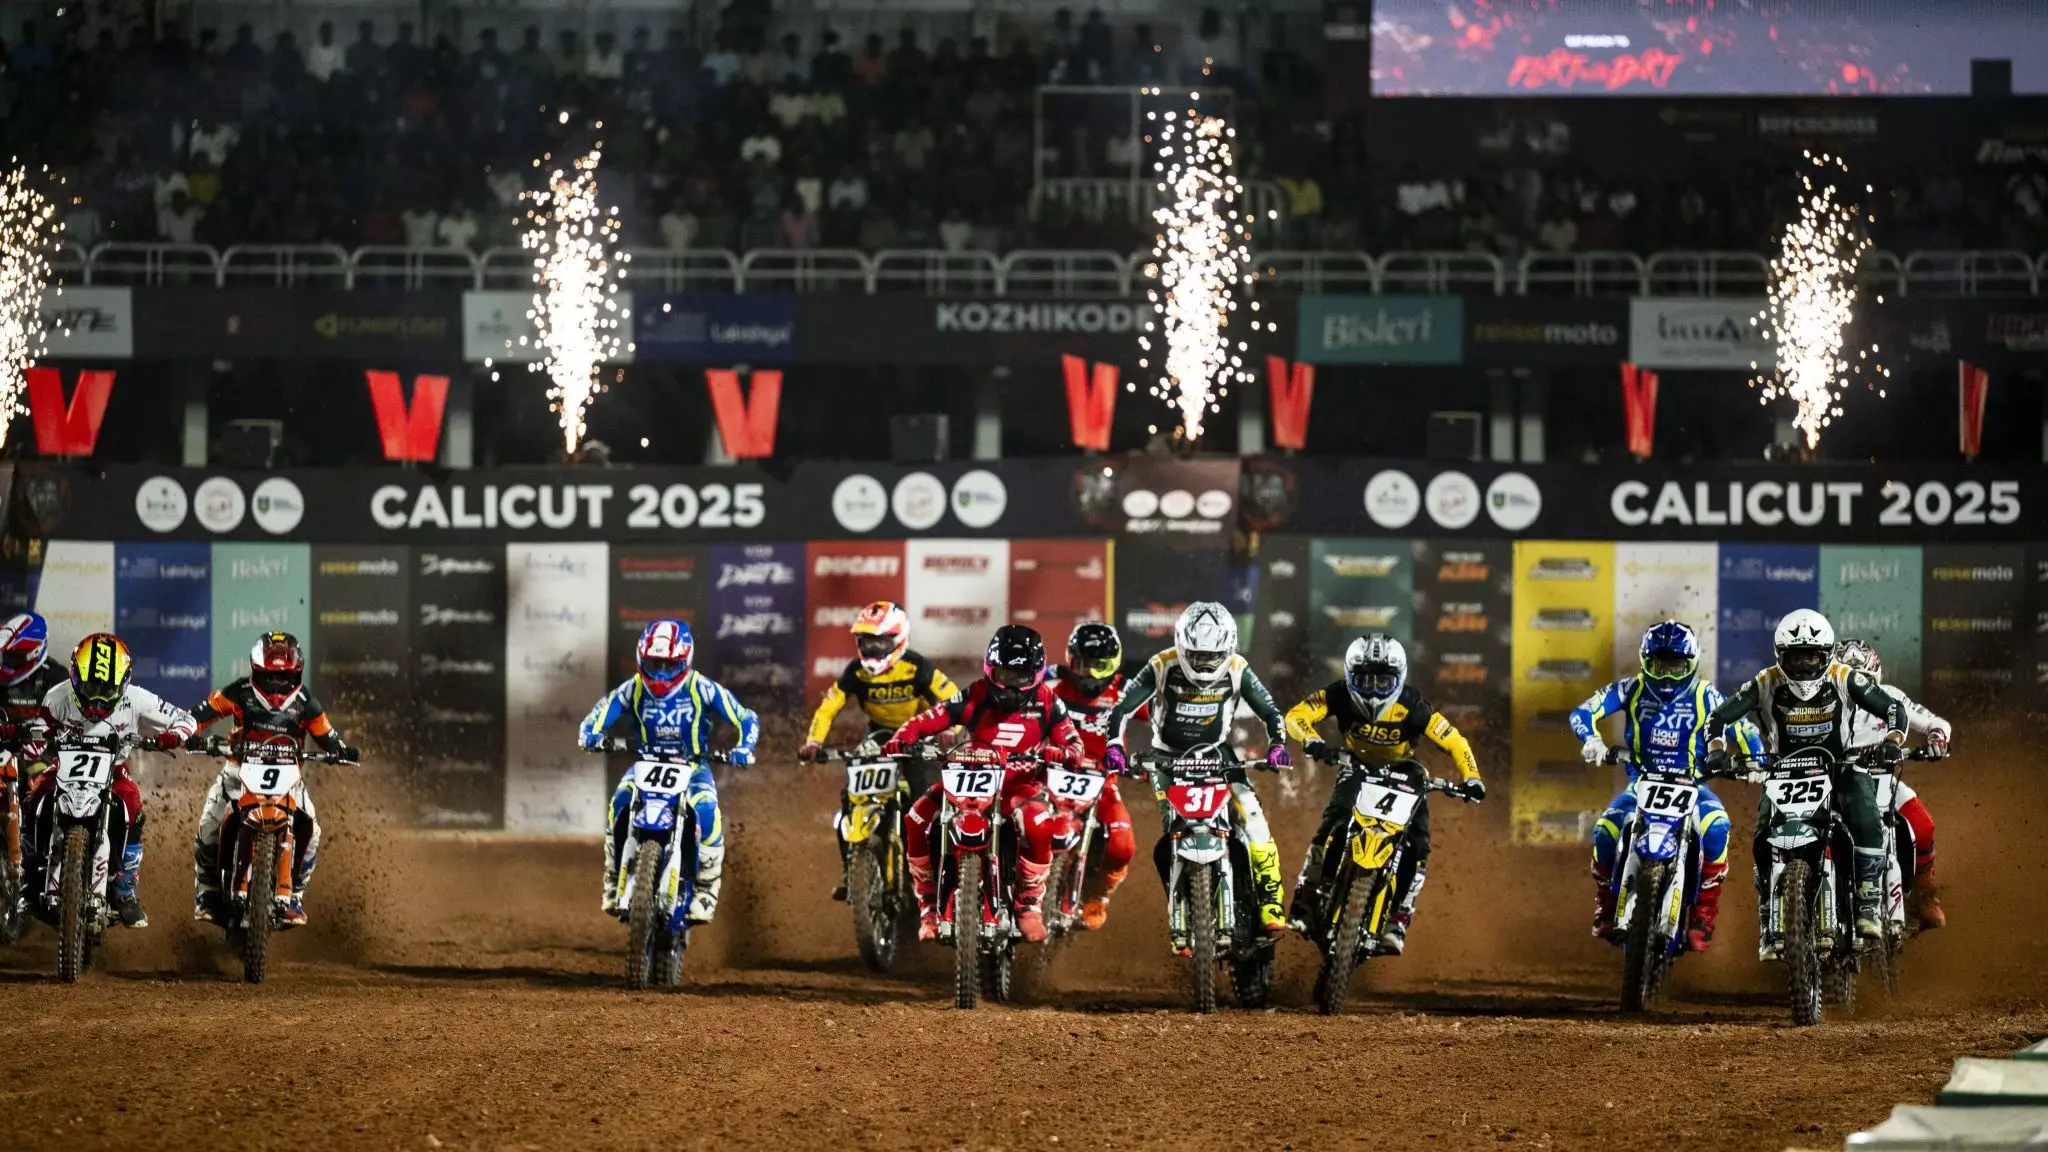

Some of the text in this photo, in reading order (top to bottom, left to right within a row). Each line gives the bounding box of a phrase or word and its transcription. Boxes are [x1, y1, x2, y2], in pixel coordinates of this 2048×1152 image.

[1475, 321, 1618, 345] reisemoto
[371, 484, 766, 529] CALICUT 2025
[1610, 480, 2021, 526] CALICUT 2025
[814, 555, 900, 577] DUCATI
[94, 642, 112, 682] FXR
[868, 684, 914, 699] reise
[641, 707, 694, 726] FXR
[1639, 708, 1695, 730] FXR
[1652, 738, 1678, 748] MOLY
[1653, 728, 1678, 739] LIQUI
[69, 754, 102, 778] 21
[1780, 761, 1819, 769] RENTHAL
[260, 768, 280, 790] 9
[644, 765, 681, 789] 46
[855, 768, 891, 793] 100
[956, 772, 993, 793] 112
[1058, 774, 1091, 796] 33
[1184, 787, 1215, 812] 31
[1374, 792, 1398, 815] 4
[1644, 785, 1693, 813] 154
[1776, 779, 1826, 805] 325
